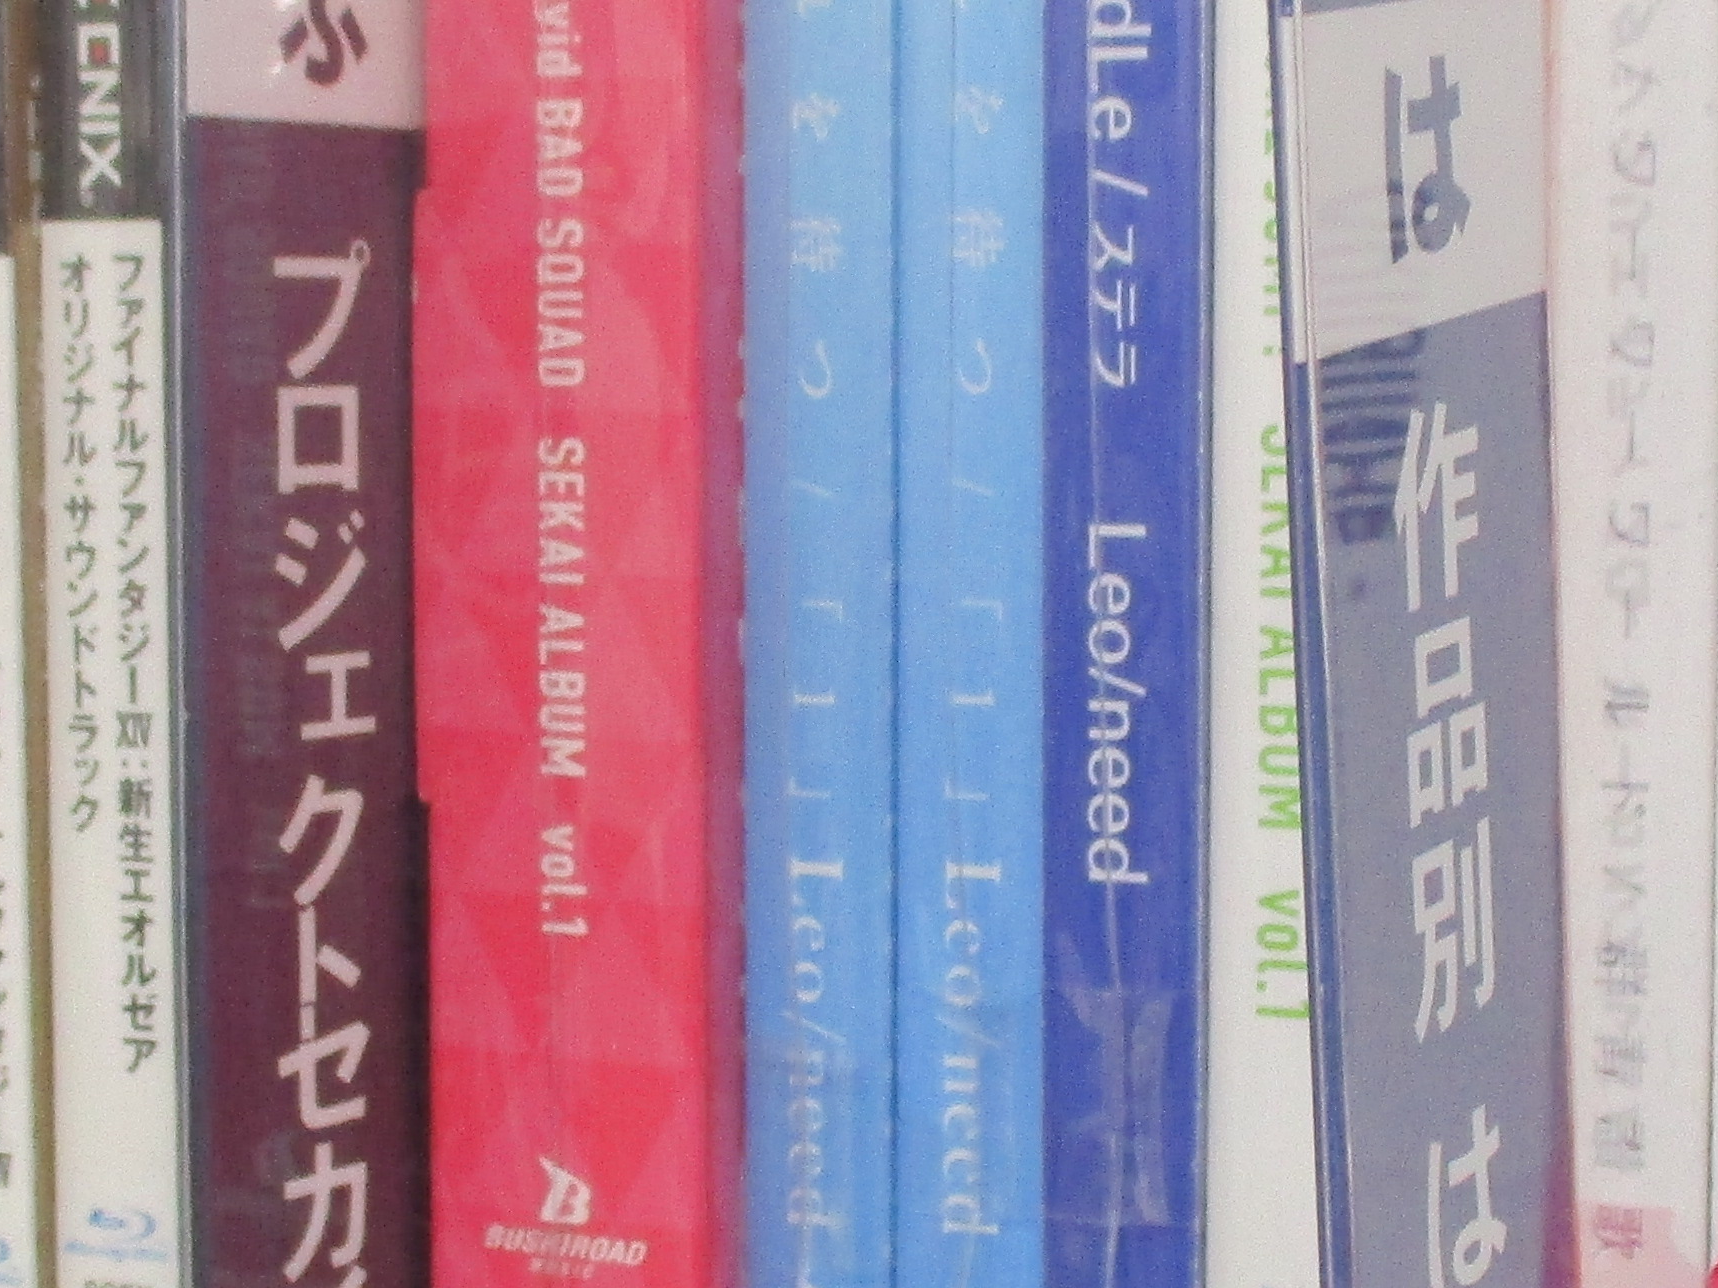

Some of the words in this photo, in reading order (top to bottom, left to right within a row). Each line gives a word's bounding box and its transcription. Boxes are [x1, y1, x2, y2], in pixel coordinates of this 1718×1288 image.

[76, 22, 126, 210] ENIX
[535, 96, 585, 198] BAD
[1383, 53, 1472, 266] は
[536, 214, 587, 391] SQUAD
[1092, 222, 1140, 389] ステラ
[537, 438, 587, 592] SEKAI
[538, 605, 587, 779] ALBUM
[1084, 521, 1151, 887] Leo/need
[1391, 399, 1496, 1044] 作品別
[540, 823, 589, 938] vol.1
[1253, 888, 1312, 1022] vol.1
[944, 857, 1002, 1238] Leo/need
